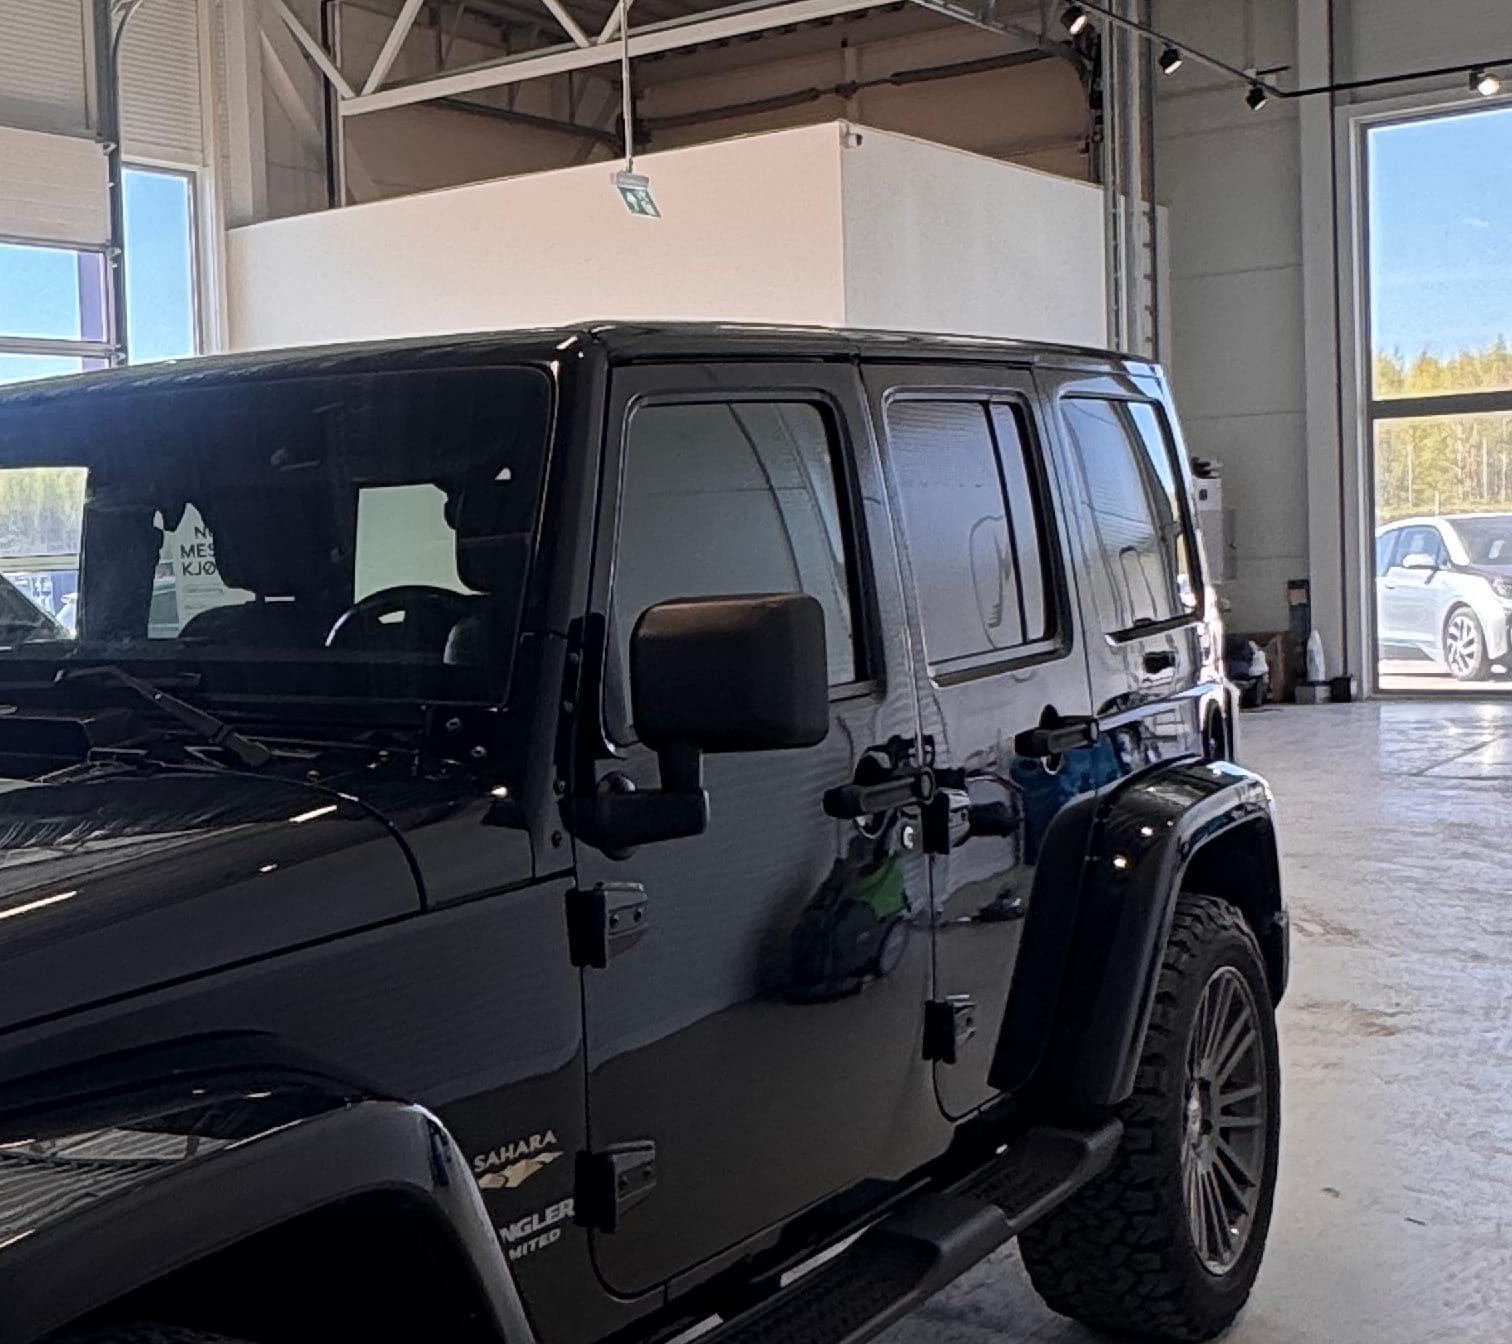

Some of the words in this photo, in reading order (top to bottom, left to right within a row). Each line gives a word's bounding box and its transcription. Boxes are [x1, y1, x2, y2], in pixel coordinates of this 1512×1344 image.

[180, 543, 215, 559] MES
[182, 560, 217, 576] KJØ
[474, 1129, 558, 1172] SAHARA
[499, 1197, 576, 1243] NGLER
[508, 1228, 562, 1261] MITED
